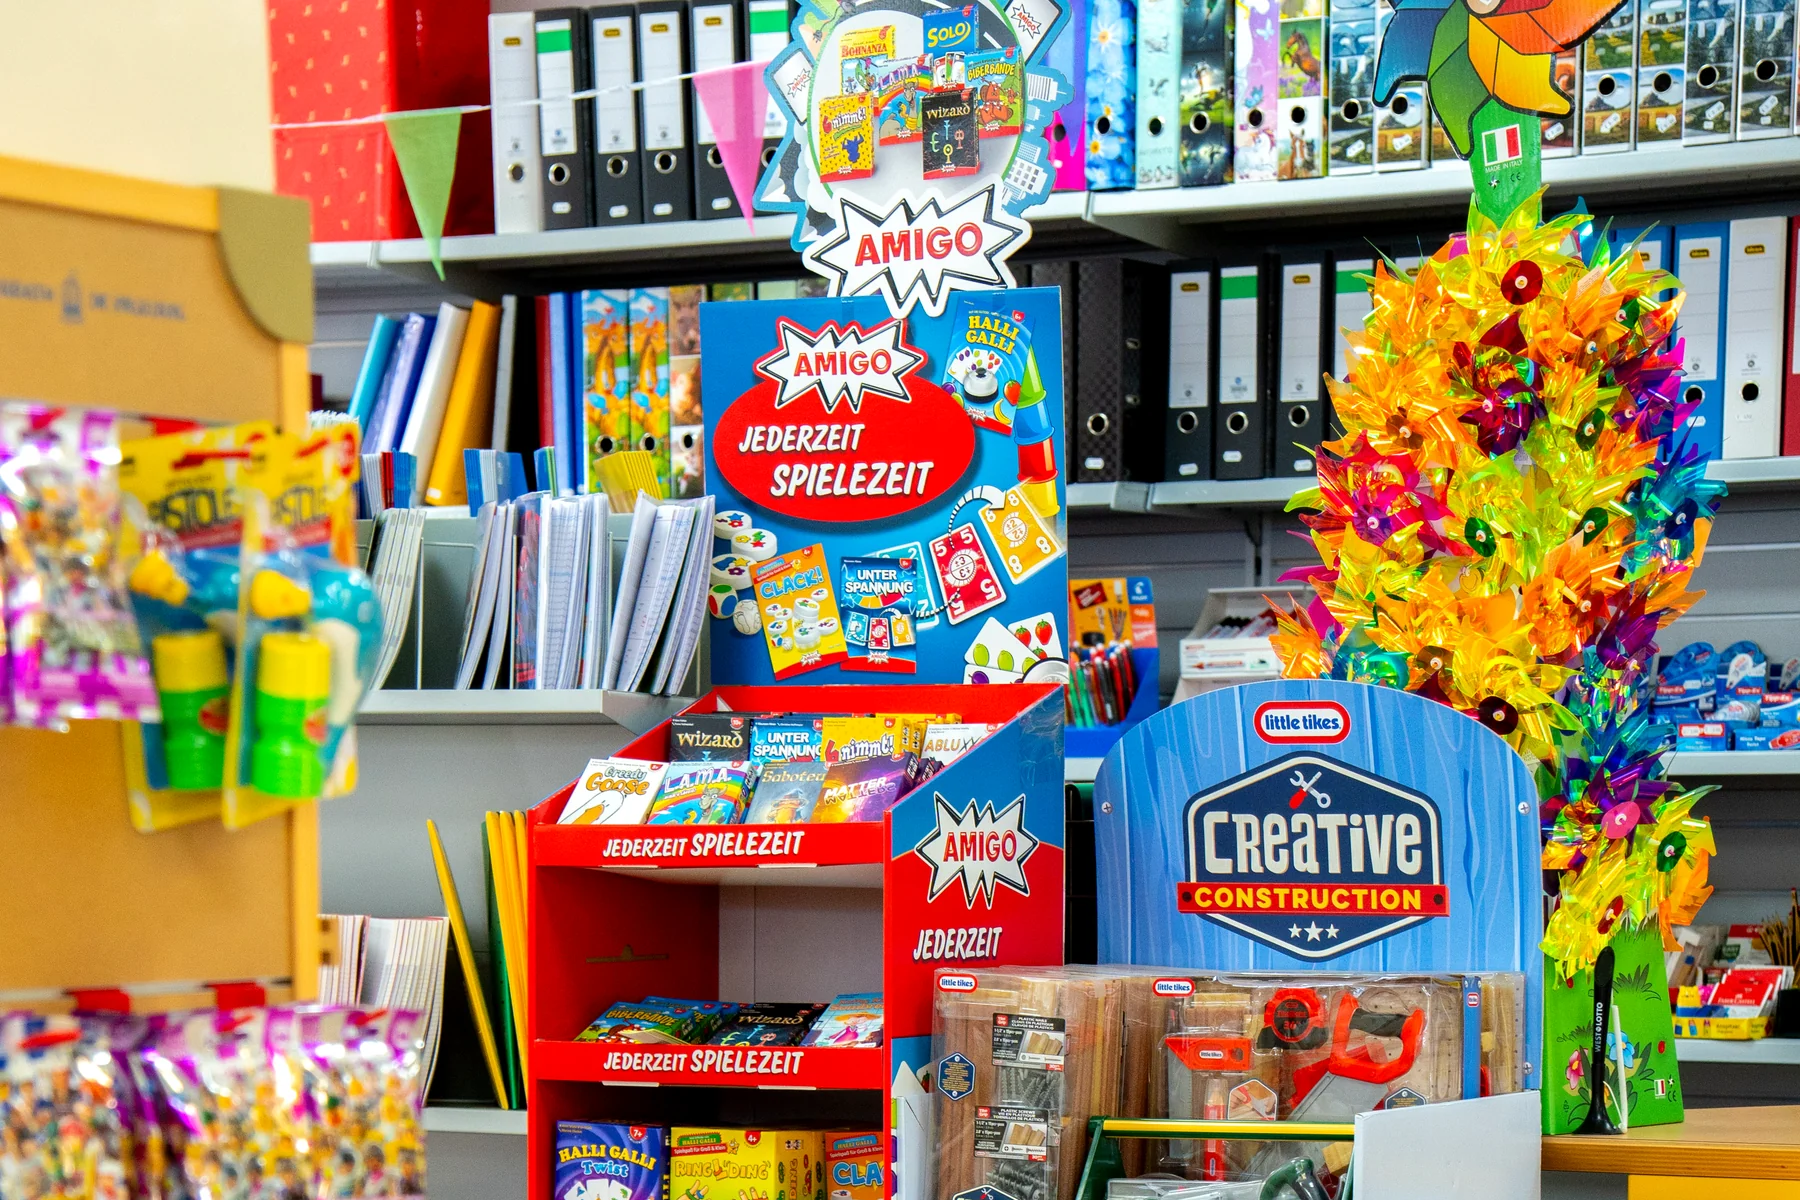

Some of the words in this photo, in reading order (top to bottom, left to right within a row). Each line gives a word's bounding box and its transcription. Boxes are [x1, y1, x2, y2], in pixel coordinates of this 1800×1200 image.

[1016, 11, 1036, 32] AMIGO
[927, 22, 967, 47] SOLO
[967, 63, 1015, 82] BIBERBANDE
[832, 108, 867, 129] nimmt!
[1485, 163, 1501, 173] MADE
[1509, 159, 1523, 167] ITALY
[855, 222, 983, 267] AMIGO
[968, 315, 1020, 341] HALLI
[965, 330, 1015, 354] GALLI
[793, 349, 892, 377] AMIGO
[738, 423, 865, 454] JEDERZEIT
[769, 460, 934, 497] SPIELEZEIT
[961, 529, 974, 545] 5
[935, 541, 948, 557] 5
[759, 565, 825, 599] CLACK!
[857, 569, 897, 582] UNTER
[845, 581, 913, 597] SPANNUNG
[1264, 714, 1299, 731] little
[1302, 714, 1342, 731] tikes
[767, 732, 810, 745] UNTER
[824, 740, 838, 761] 6
[839, 734, 895, 762] nimmt!
[924, 735, 982, 754] ABLUXX
[604, 766, 648, 782] Greedy
[761, 770, 826, 783] Saboteu
[826, 776, 887, 798] MATTER
[602, 838, 688, 858] JEDERZEIT
[690, 831, 805, 857] SPIELEZEIT
[943, 829, 1018, 863] AMIGO
[1194, 887, 1422, 911] CONSTRUCTION
[912, 926, 1003, 962] JEDERZEIT
[941, 978, 956, 987] little
[957, 979, 973, 988] tikes
[1157, 983, 1173, 991] little
[1173, 983, 1190, 991] tikes
[605, 1010, 677, 1027] BIBERBANDE
[603, 1052, 688, 1072] JEDERZEIT
[690, 1049, 804, 1075] SPIELEZEIT
[633, 1129, 643, 1137] 7+
[748, 1134, 757, 1142] 4+
[558, 1144, 606, 1163] HALLI
[609, 1145, 657, 1170] GALLI
[581, 1160, 629, 1178] Twist
[832, 1161, 884, 1187] CLA
